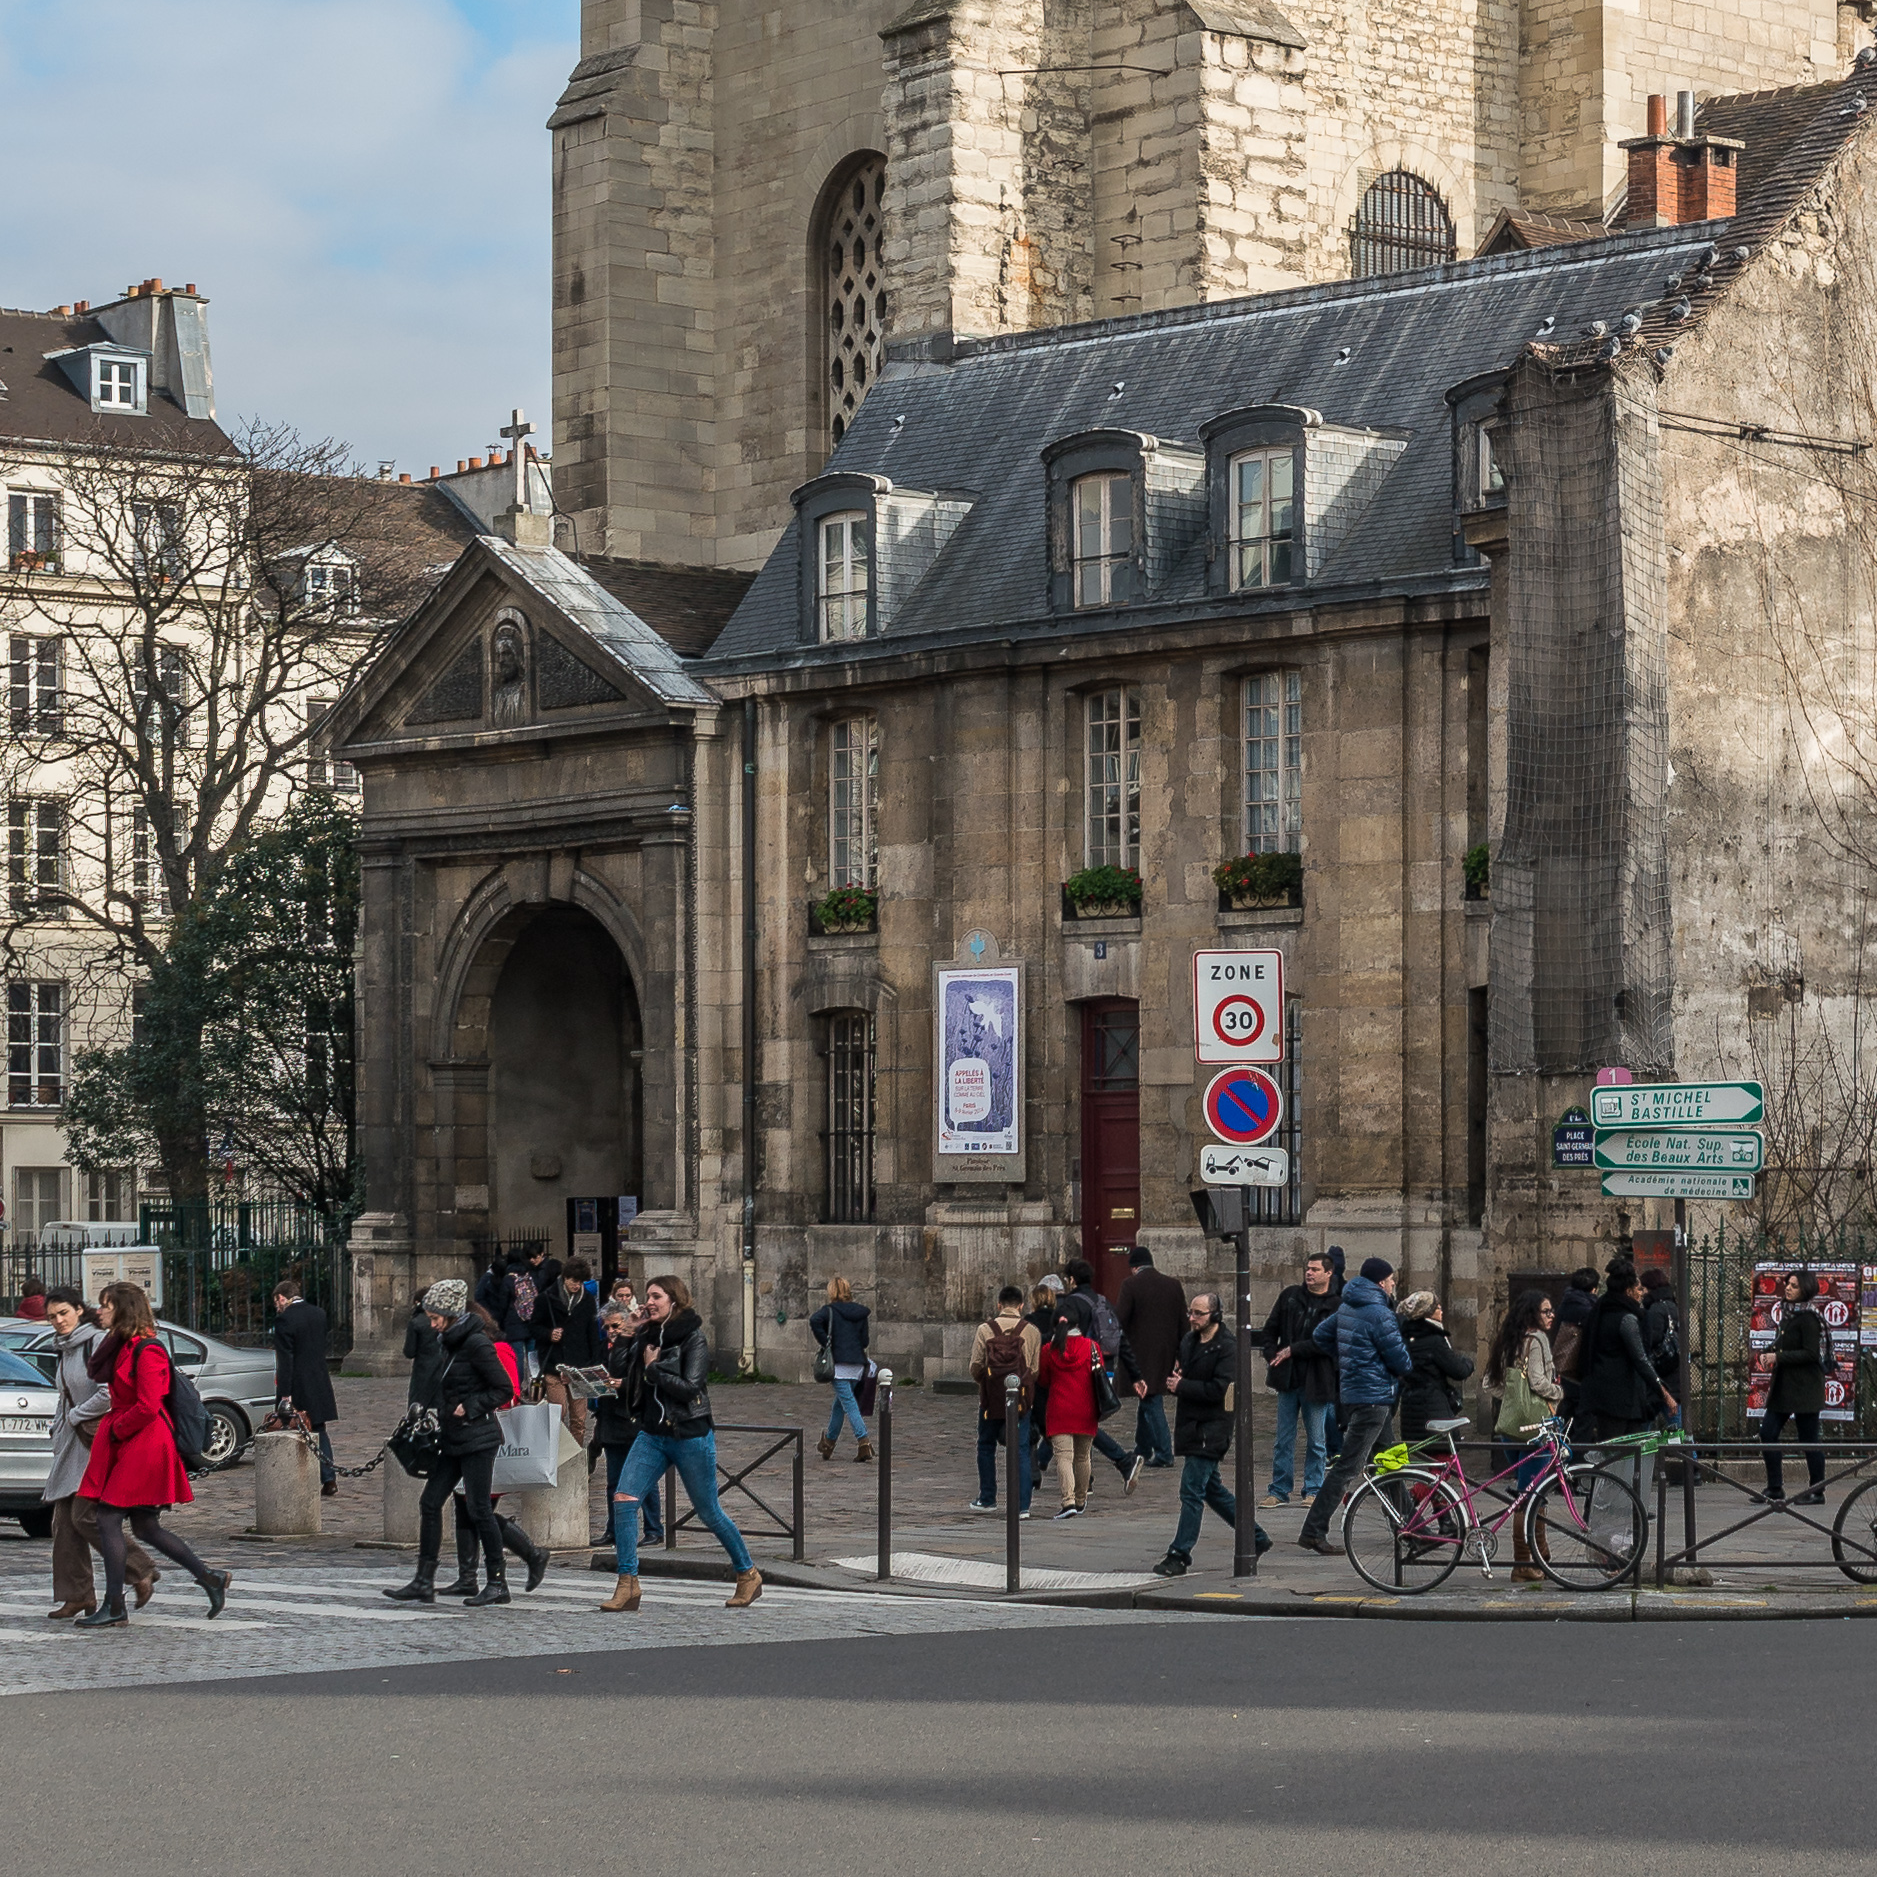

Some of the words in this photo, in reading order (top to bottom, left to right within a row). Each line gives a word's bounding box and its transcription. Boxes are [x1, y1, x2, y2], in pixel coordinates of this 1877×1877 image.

[1096, 943, 1104, 957] 3
[1211, 964, 1265, 980] ZONE
[1225, 1011, 1253, 1030] 30
[1608, 1069, 1617, 1084] 1
[1652, 1091, 1711, 1105] MICHEL
[1631, 1105, 1703, 1120] BASTILLE
[1566, 1131, 1585, 1140] PLACE
[1626, 1134, 1660, 1149] École
[1666, 1137, 1691, 1150] Nat.
[1697, 1137, 1724, 1153] Sup.
[1562, 1152, 1574, 1161] DES
[1574, 1151, 1589, 1161] PRÉS
[1626, 1150, 1648, 1162] des
[1651, 1150, 1691, 1164] Beaux
[1696, 1151, 1724, 1165] Arts
[1628, 1175, 1675, 1184] Académie
[1681, 1176, 1727, 1186] nationale
[1664, 1186, 1675, 1195] de
[1680, 1187, 1727, 1197] médecine
[498, 1444, 530, 1457] Mara
